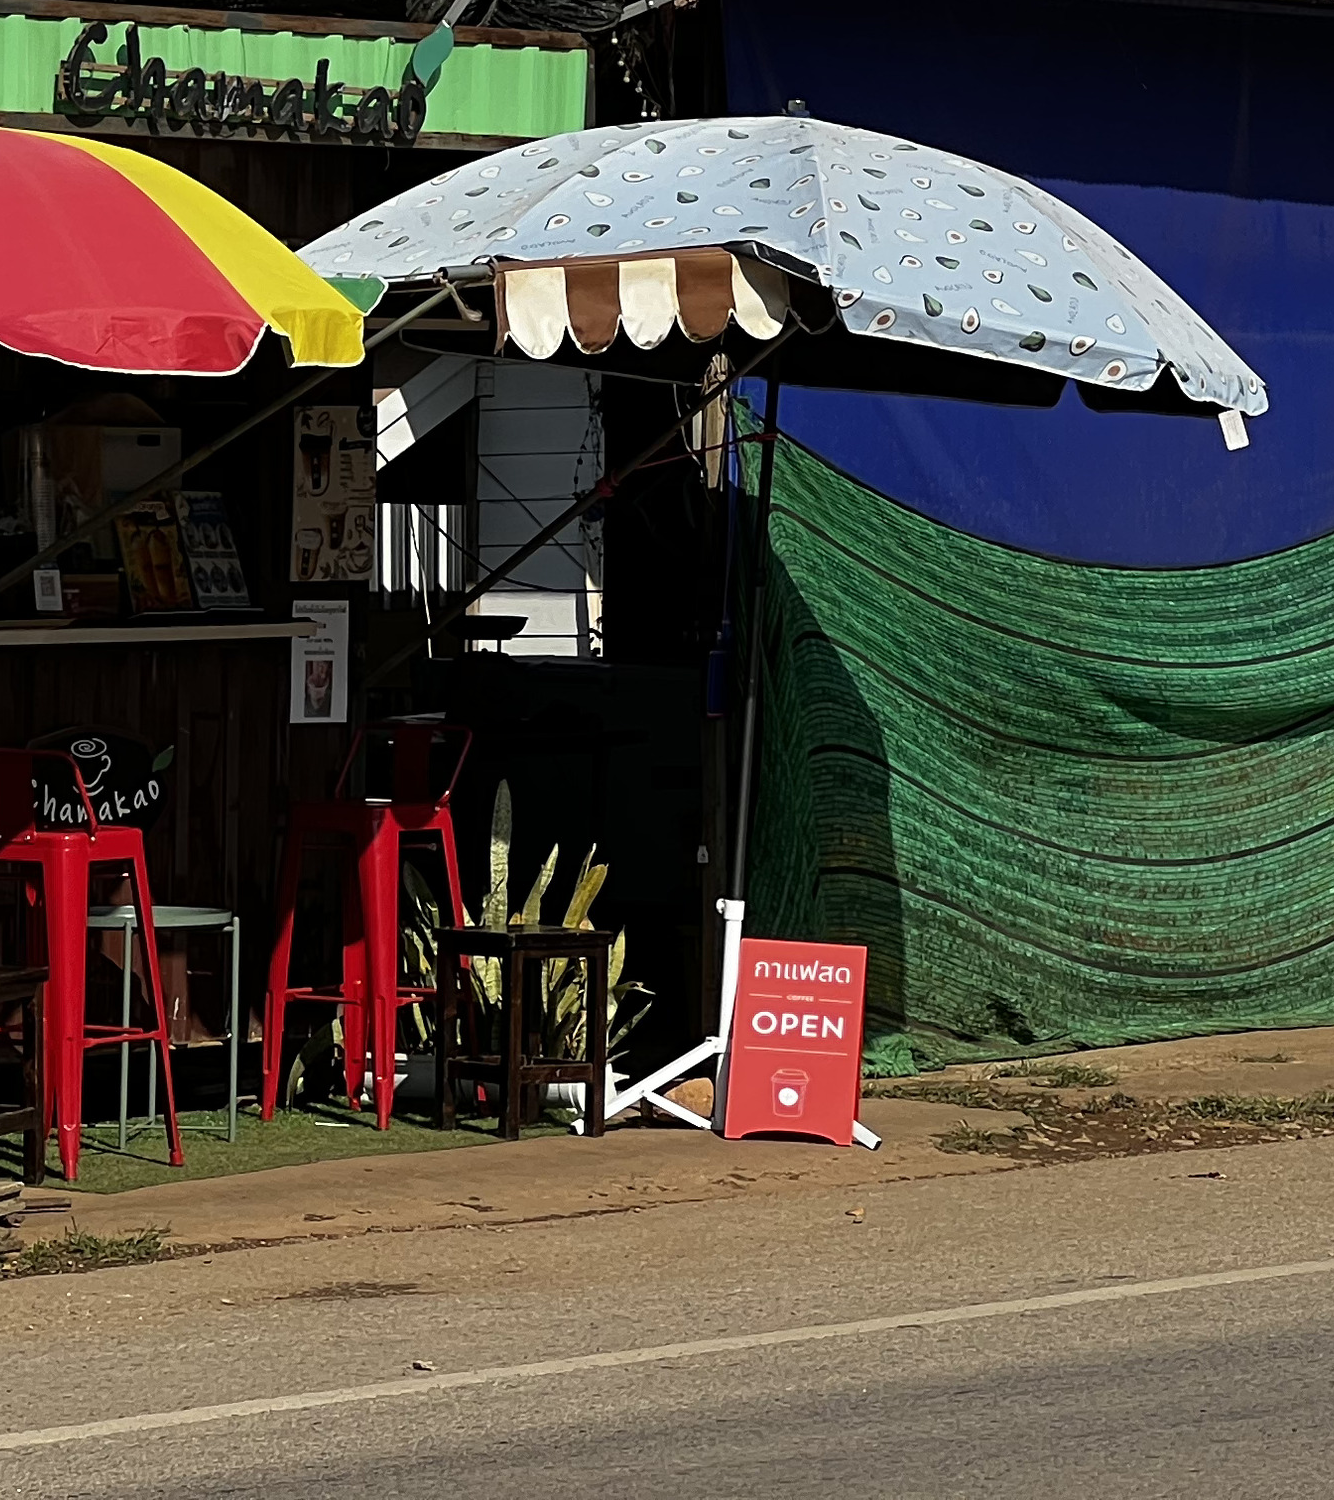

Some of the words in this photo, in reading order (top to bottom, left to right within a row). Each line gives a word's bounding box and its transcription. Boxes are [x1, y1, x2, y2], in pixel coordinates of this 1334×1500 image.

[65, 21, 426, 141] Chamakao
[32, 779, 160, 824] hamakao
[754, 960, 851, 984] กาแฟสด
[752, 1011, 844, 1040] OPEN
